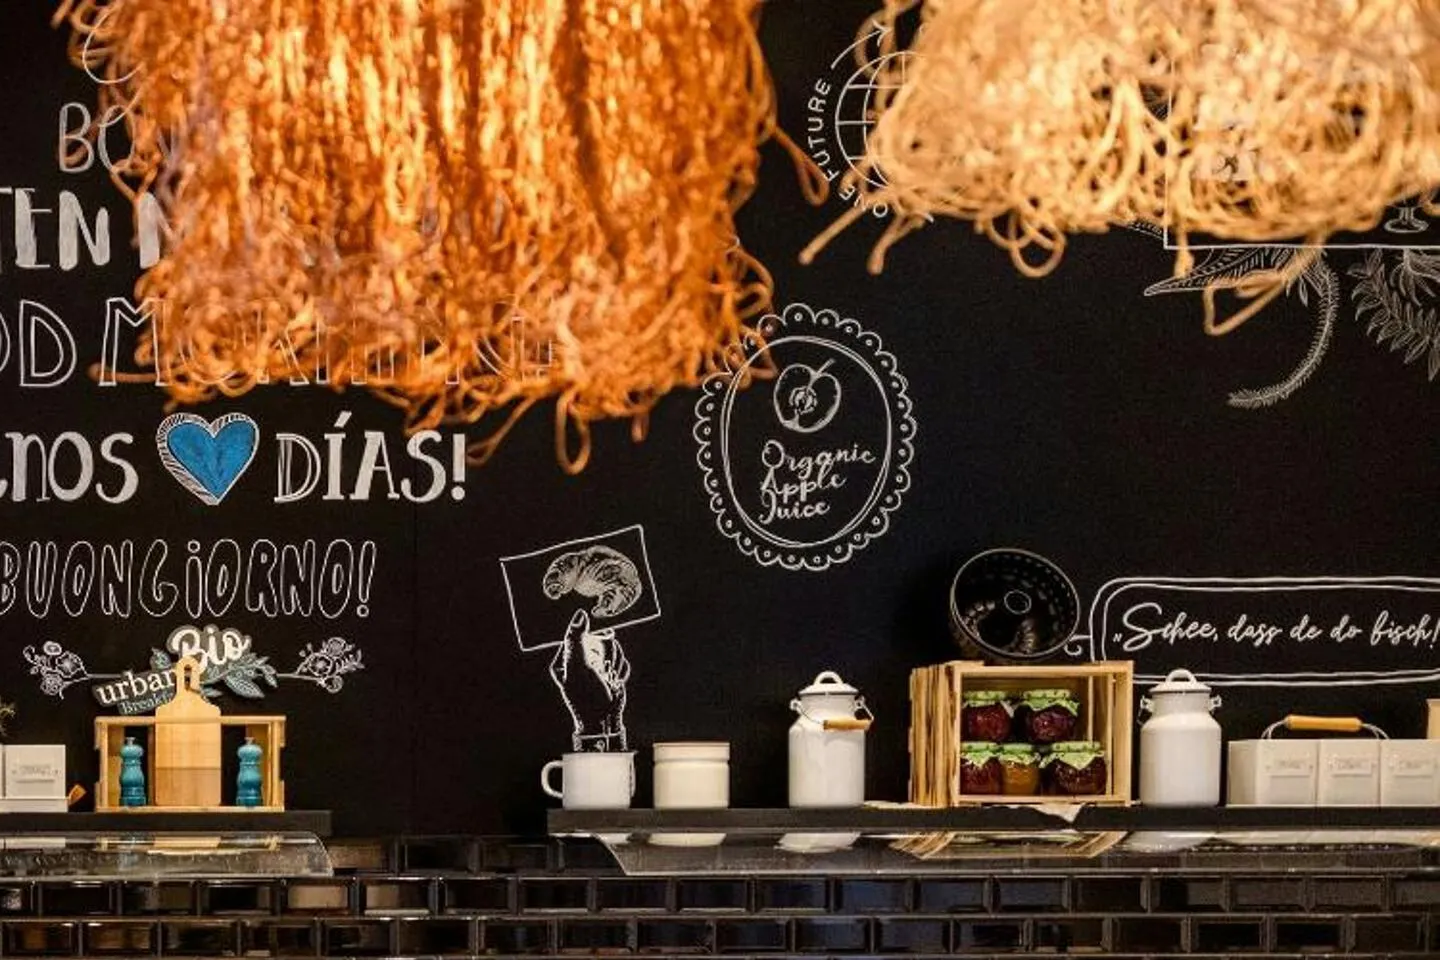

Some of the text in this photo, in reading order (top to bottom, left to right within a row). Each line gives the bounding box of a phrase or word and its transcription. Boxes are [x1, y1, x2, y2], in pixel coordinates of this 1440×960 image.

[808, 78, 840, 181] FUTURE
[274, 411, 466, 502] DÍAS!
[762, 440, 876, 479] Organic
[760, 460, 847, 503] Apple
[759, 489, 831, 525] Juice
[1290, 614, 1323, 641] de
